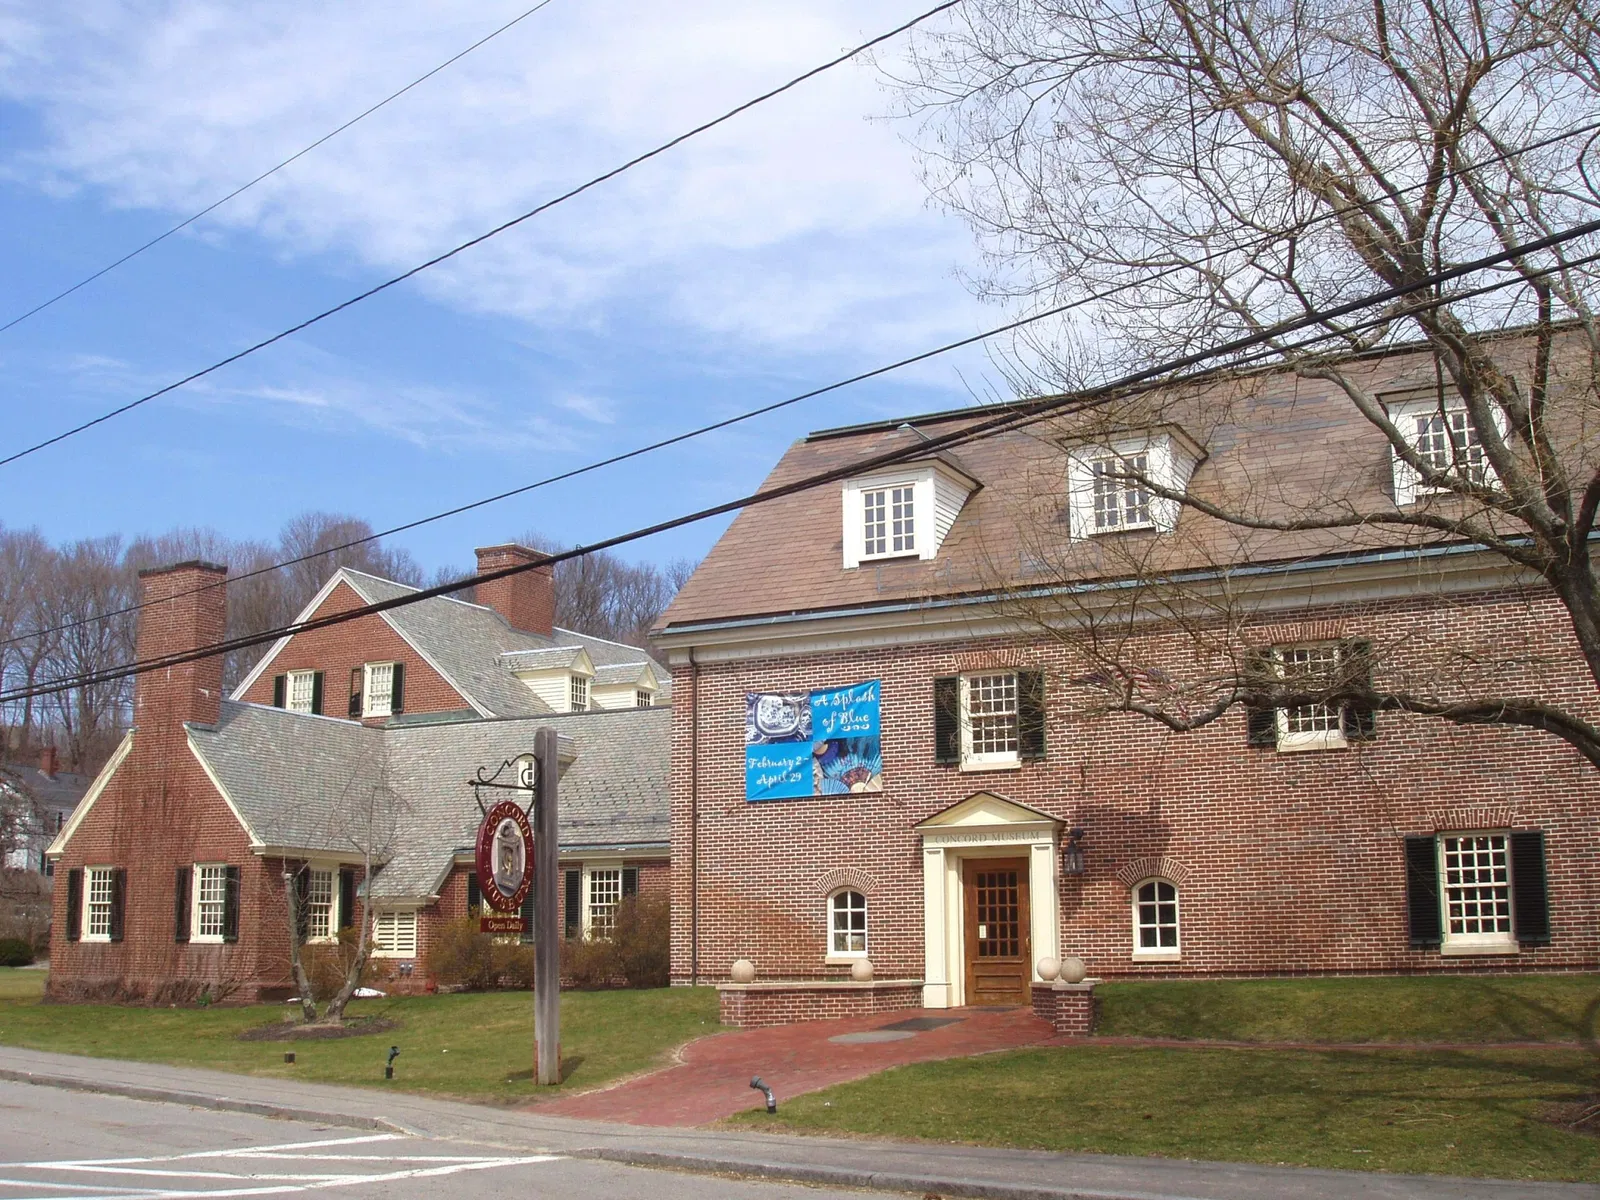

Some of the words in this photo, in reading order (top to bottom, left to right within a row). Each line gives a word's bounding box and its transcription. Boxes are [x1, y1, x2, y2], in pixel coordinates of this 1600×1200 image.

[814, 694, 829, 707] A
[831, 685, 875, 711] Splash
[822, 711, 838, 733] of
[838, 711, 870, 725] Blue
[748, 756, 794, 771] February
[756, 770, 787, 788] April
[789, 772, 802, 782] 29
[486, 804, 530, 838] CONCORD
[935, 833, 987, 844] CONCORD
[991, 831, 1040, 842] MUSEUM
[485, 876, 531, 910] MUSEUM
[488, 920, 506, 931] Open
[507, 920, 524, 931] Daily
